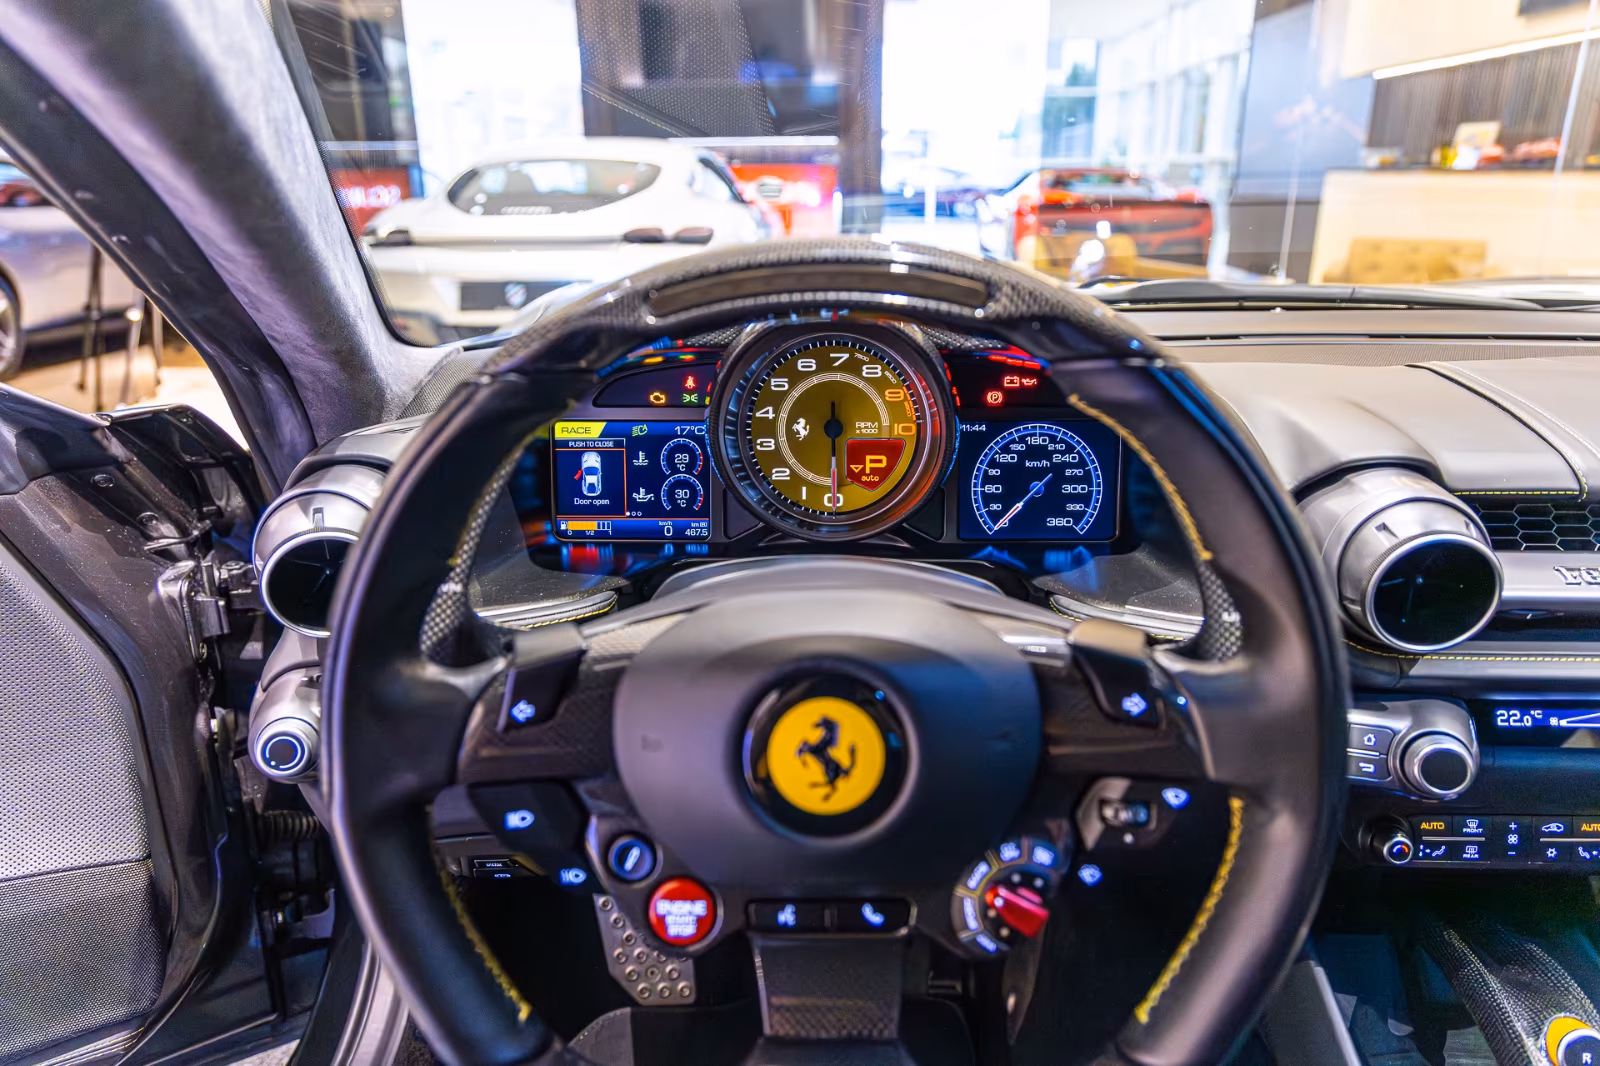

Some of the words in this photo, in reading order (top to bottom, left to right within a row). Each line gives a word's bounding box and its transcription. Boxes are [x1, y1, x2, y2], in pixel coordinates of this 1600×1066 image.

[797, 358, 816, 372] 6
[830, 354, 850, 366] 7
[862, 364, 882, 378] 8
[770, 378, 789, 390] 5
[884, 388, 904, 402] 9
[756, 406, 776, 420] 4
[561, 426, 592, 434] RACE
[674, 426, 706, 435] 17°C
[894, 424, 916, 436] 10
[756, 438, 776, 450] 3
[1025, 436, 1049, 444] 180
[674, 454, 689, 463] 29
[994, 454, 1018, 462] 120
[1052, 454, 1078, 462] 240
[866, 455, 887, 474] P
[772, 468, 790, 480] 2
[675, 490, 690, 499] 30
[984, 485, 1002, 493] 60
[1062, 485, 1088, 493] 300
[824, 494, 844, 507] 0
[1046, 518, 1073, 526] 360
[664, 526, 672, 536] 0
[1420, 822, 1445, 830] AUTO
[1582, 1052, 1592, 1064] R
